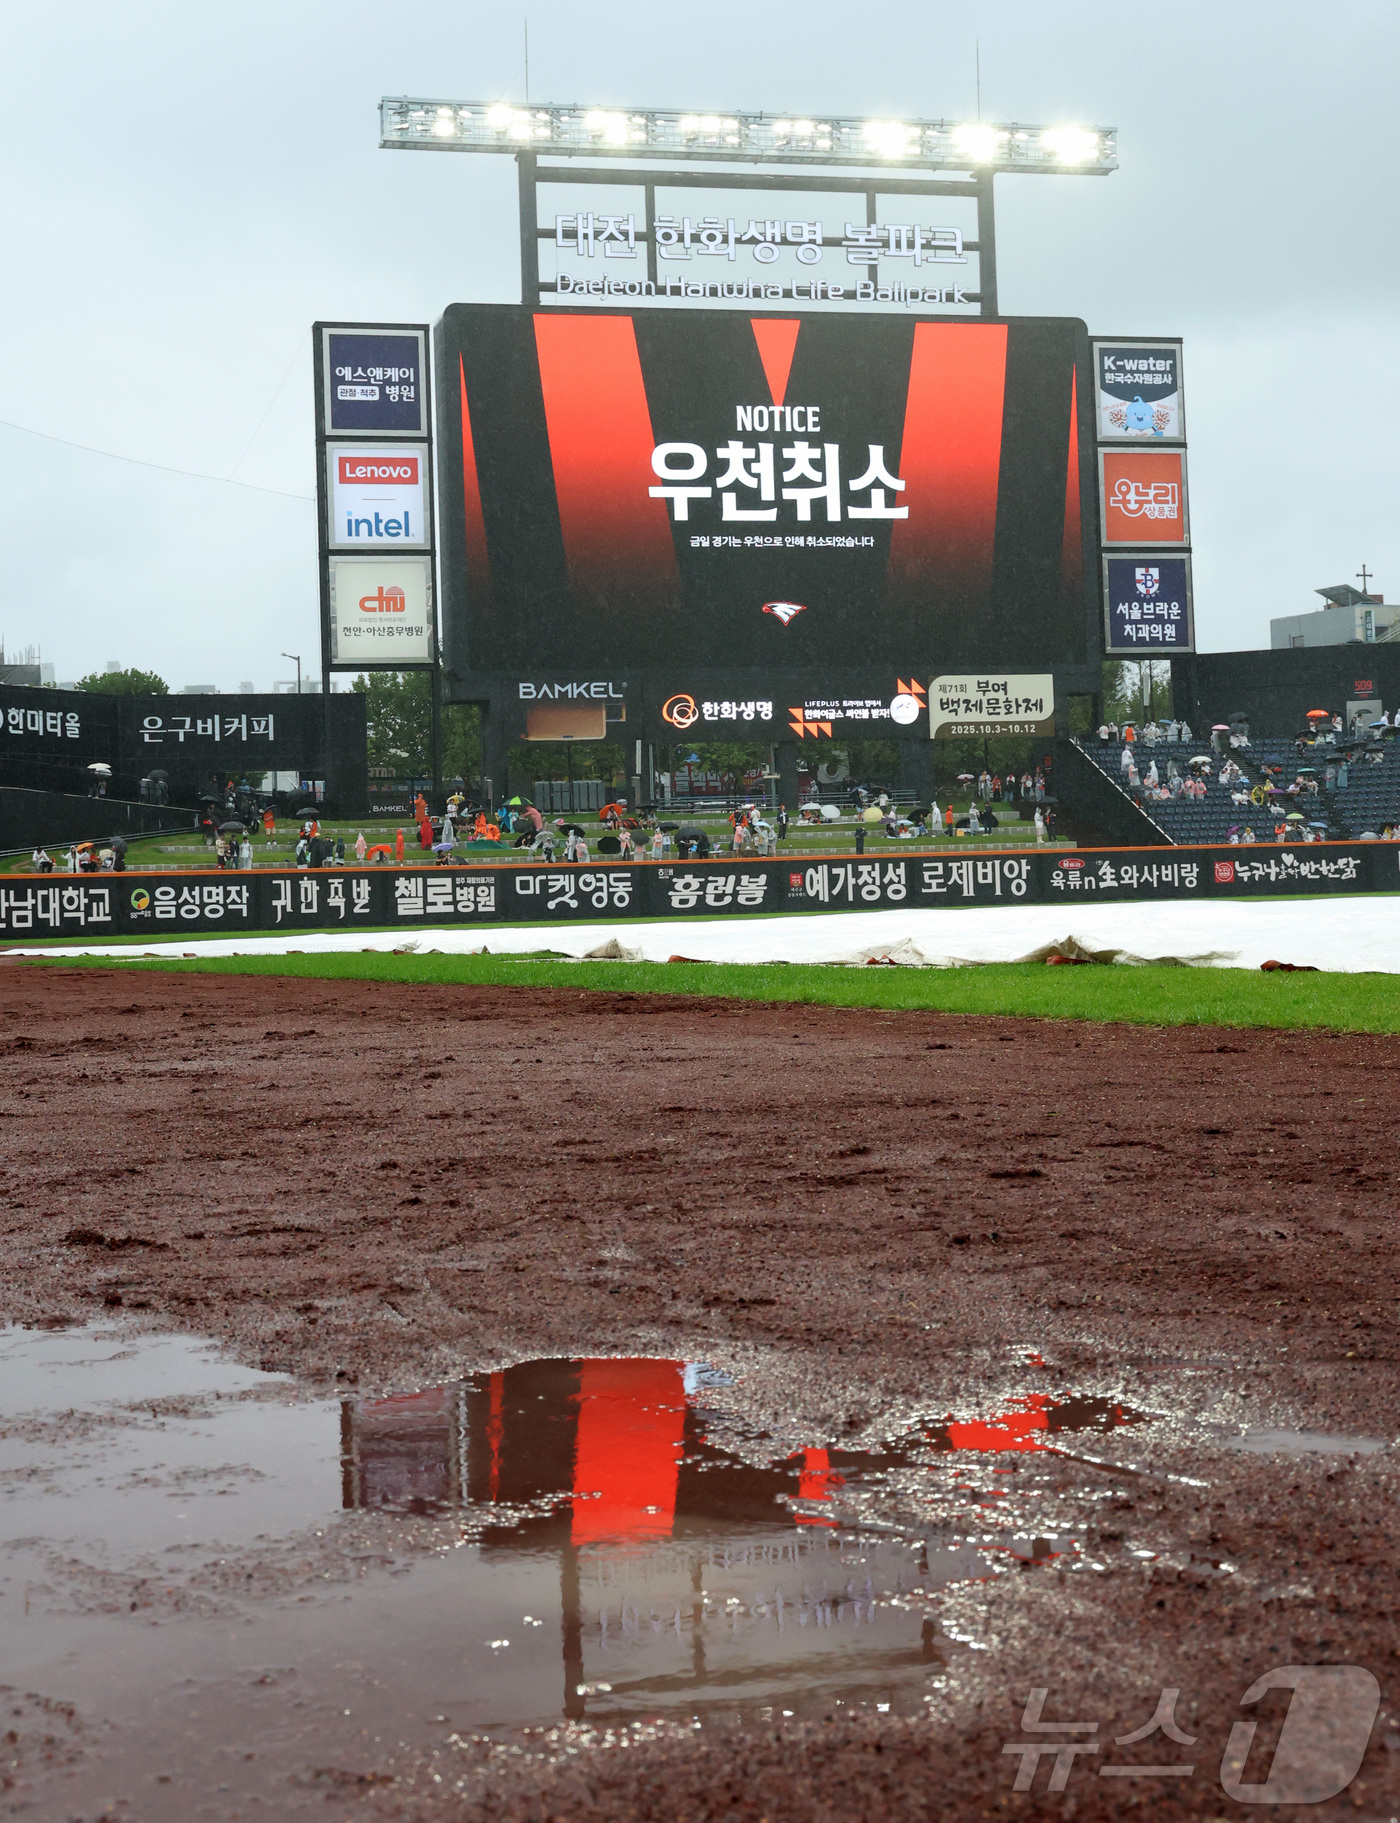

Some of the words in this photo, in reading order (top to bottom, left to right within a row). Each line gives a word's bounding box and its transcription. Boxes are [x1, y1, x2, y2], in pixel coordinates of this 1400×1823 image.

[556, 212, 638, 259] 대전
[653, 216, 823, 264] 한화생명
[842, 222, 968, 266] 볼파크
[556, 272, 656, 300] Daejeon
[665, 275, 783, 299] Hanwha
[792, 279, 844, 301] Life
[856, 280, 970, 307] Ballpark
[1104, 356, 1173, 371] K-water
[336, 367, 414, 384] 에스앤케이
[1105, 372, 1172, 384] 한국수자원공사
[386, 385, 415, 402] 병원
[736, 405, 820, 432] NOTICE
[346, 463, 411, 478] Lenovo
[648, 440, 909, 522] 우천취소
[1110, 478, 1178, 517] 온누리
[1147, 506, 1177, 517] 상품권
[347, 511, 410, 537] intel
[690, 536, 710, 547] 금일
[712, 536, 742, 547] 경기는
[744, 536, 783, 547] 우천으로
[785, 536, 804, 547] 인해
[806, 536, 874, 547] 취소되었습니다
[1116, 602, 1181, 620] 서울브라운
[342, 626, 423, 637] 천안·아산충무병원
[1124, 624, 1176, 641] 치과의원
[938, 684, 967, 694] 제71회
[976, 680, 1008, 696] 부여
[1354, 680, 1373, 691] 509
[702, 701, 773, 720] 한화생명
[939, 697, 1044, 716] 백제문화제
[8, 707, 81, 738] 한미타올
[139, 714, 274, 742] 은구비커피
[951, 724, 1036, 734] 2025.10.3~10.12
[805, 862, 907, 902] 예가정성
[921, 859, 1031, 897] 로제비앙
[668, 873, 768, 909] 홈런볼
[154, 885, 249, 919] 음성명작
